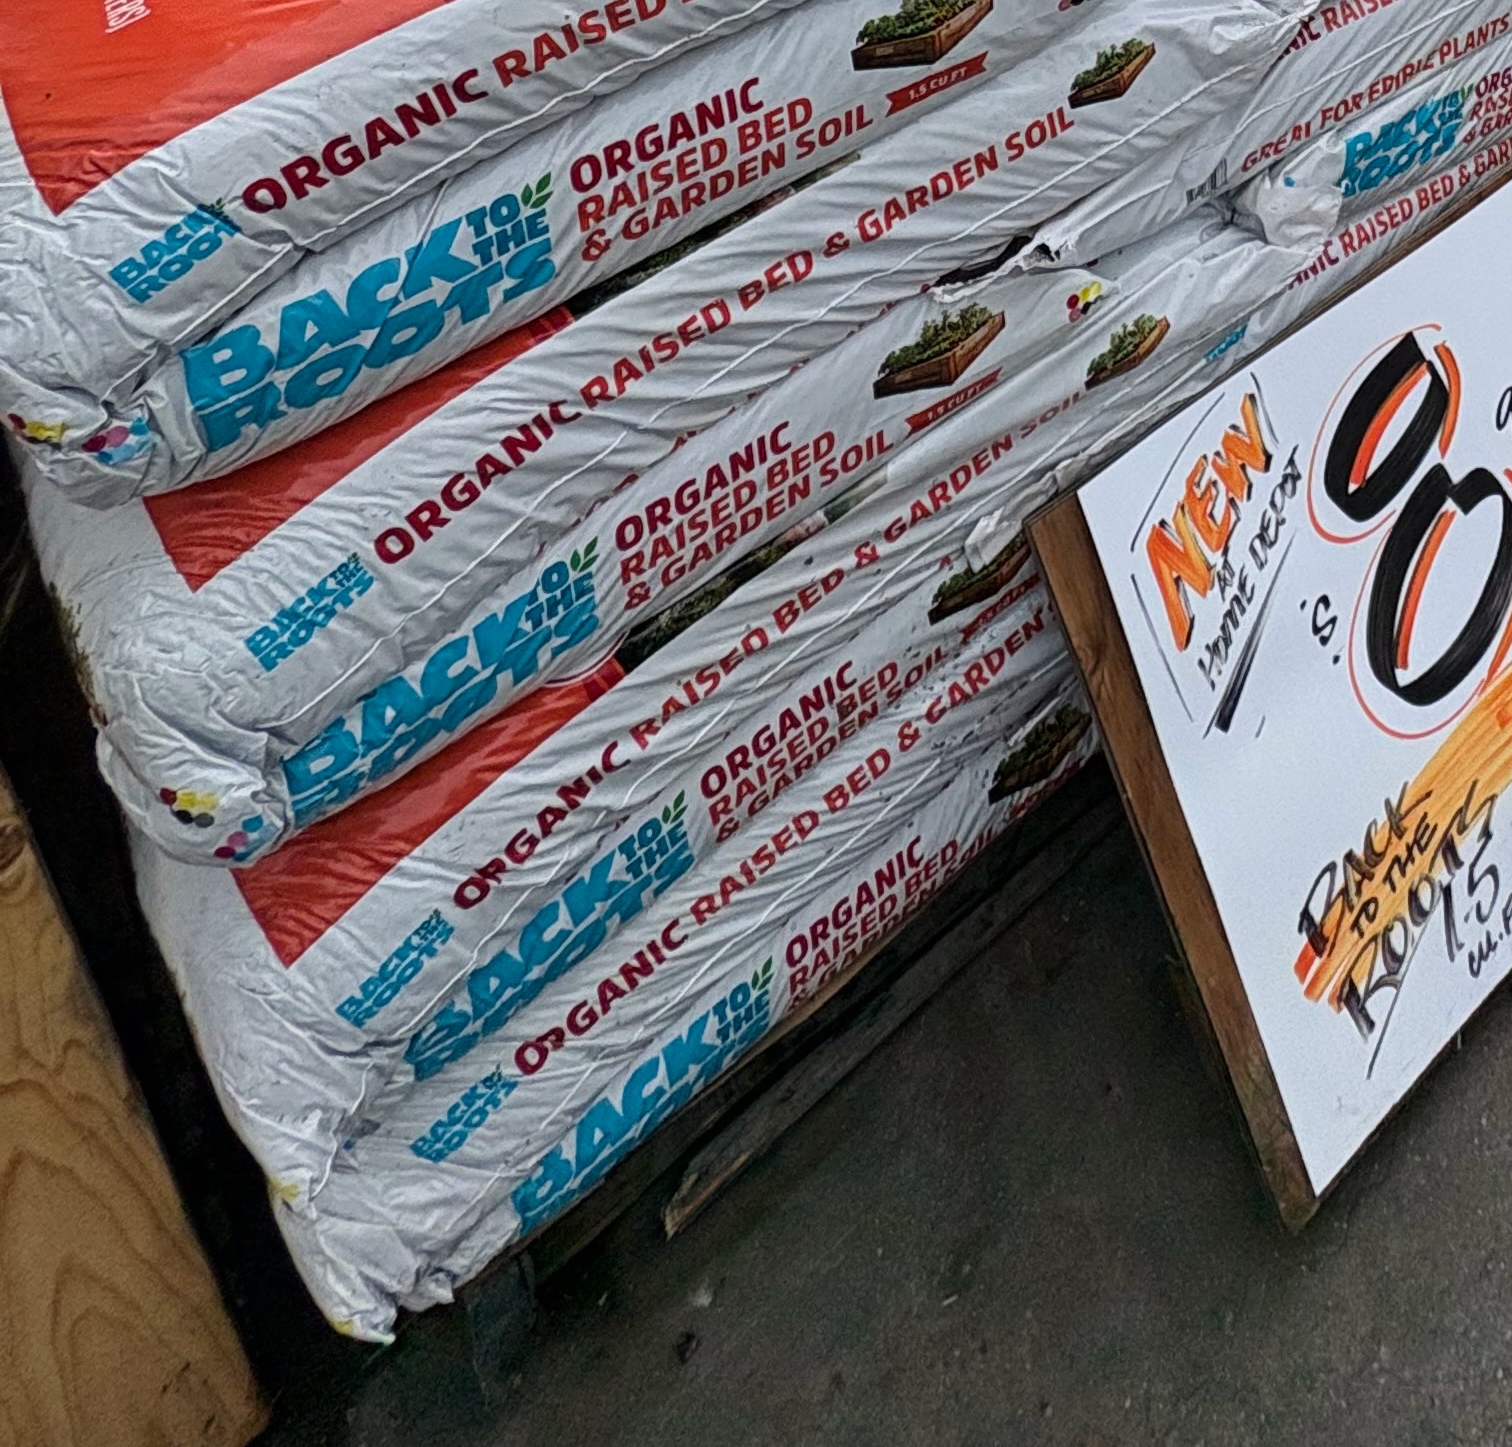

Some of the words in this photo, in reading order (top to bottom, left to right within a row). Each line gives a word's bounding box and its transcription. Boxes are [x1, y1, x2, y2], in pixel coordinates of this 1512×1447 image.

[569, 77, 765, 193] ORGANIC
[951, 66, 969, 83] FT
[1320, 92, 1363, 129] FOR
[1439, 11, 1508, 66] PLANTS
[241, 69, 488, 214] ORGANIC
[576, 139, 728, 233] RAISED
[737, 99, 813, 163] BED
[621, 143, 785, 240] GARDEN
[795, 104, 874, 160] SOIL
[466, 193, 521, 235] TO
[473, 210, 549, 264] THE
[179, 218, 479, 406] BACK
[199, 238, 556, 453] ROOTS
[374, 400, 581, 564] ORGANIC
[579, 299, 732, 409] RAISED
[739, 251, 813, 311] BED
[857, 148, 999, 243] GARDEN
[1005, 107, 1075, 162] SOIL
[613, 421, 793, 553] ORGANIC
[619, 474, 760, 585] RAISED
[763, 429, 837, 491] BED
[660, 473, 810, 590] GARDEN
[818, 429, 895, 487] SOIL
[1145, 392, 1273, 652] NEW
[524, 575, 595, 628] THE
[531, 561, 569, 603] TO
[1198, 564, 1255, 691] HOME
[1249, 444, 1302, 571] DEPOT
[1218, 545, 1236, 602] AT
[453, 740, 631, 910] ORGANIC
[629, 624, 770, 736] RAISED
[771, 567, 845, 633] BED
[883, 434, 1014, 543] GARDEN
[701, 661, 858, 798] ORGANIC
[617, 817, 662, 857] TO
[624, 819, 688, 878] THE
[690, 809, 821, 925] RAISED
[823, 748, 891, 815] BED
[785, 835, 926, 968] ORGANIC
[1298, 782, 1433, 959] BACK
[1349, 895, 1378, 939] TO
[1383, 812, 1438, 892] THE
[1341, 779, 1499, 1043] ROOTS
[713, 980, 753, 1021] TO
